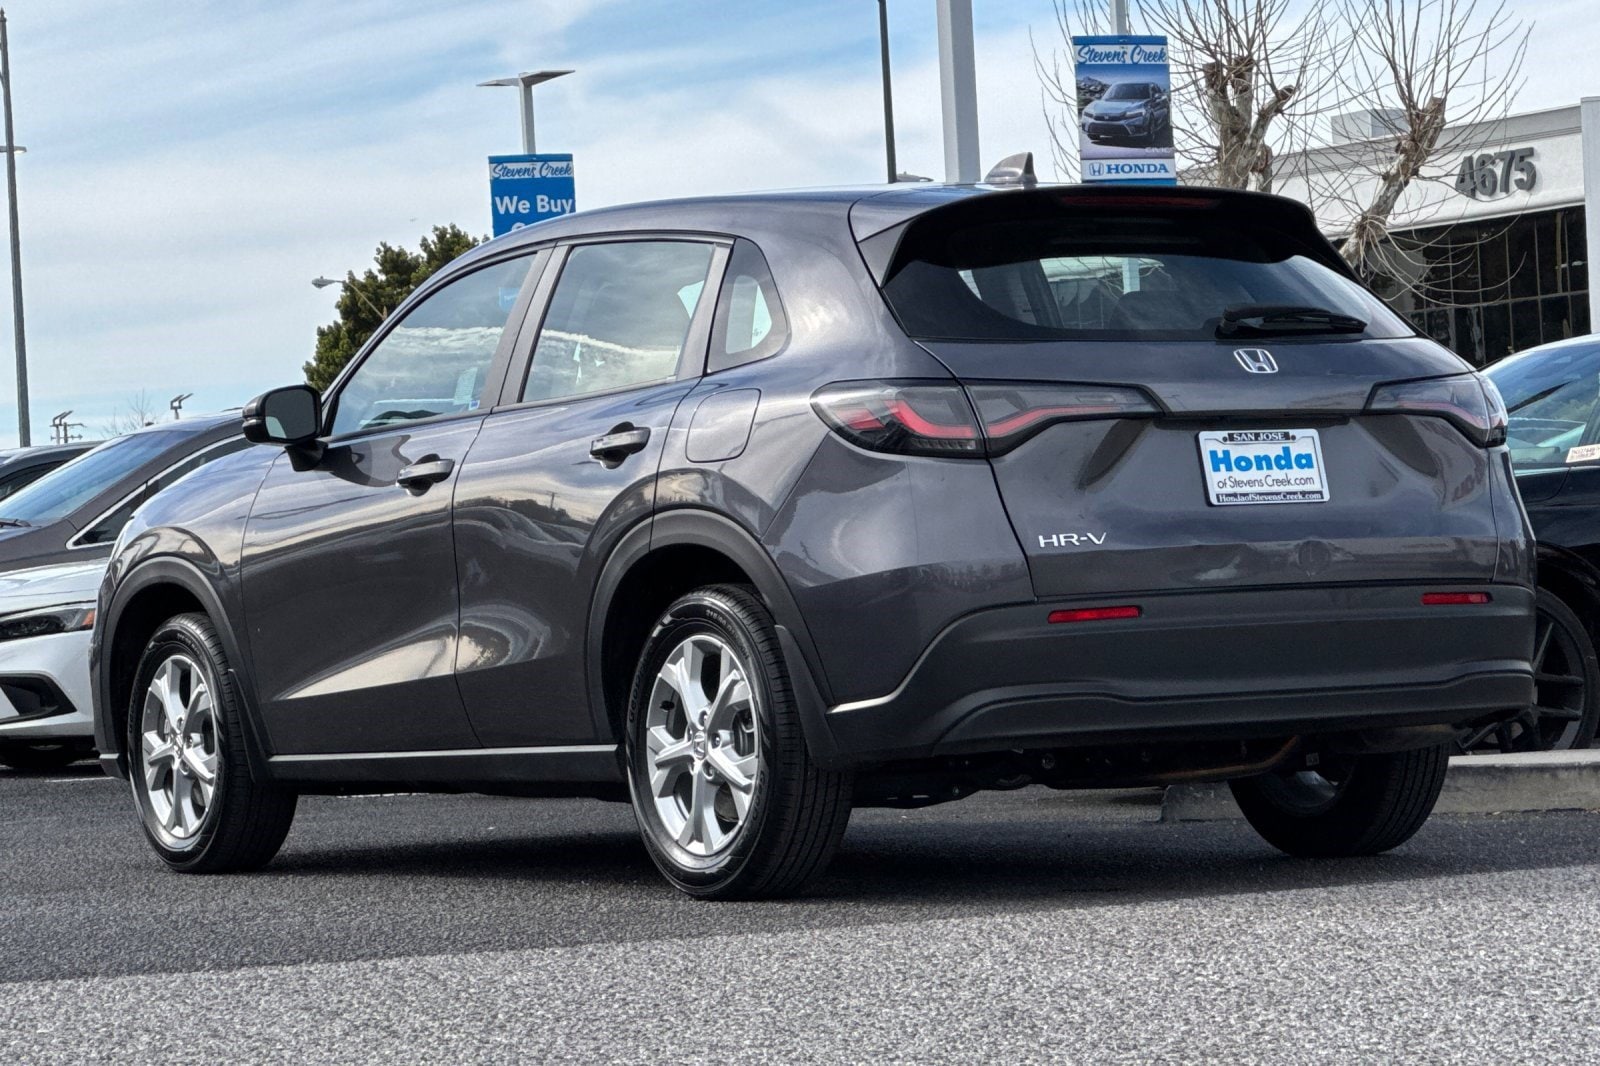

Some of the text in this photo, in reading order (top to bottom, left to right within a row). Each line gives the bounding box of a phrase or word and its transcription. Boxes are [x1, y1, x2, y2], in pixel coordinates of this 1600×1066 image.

[1077, 44, 1167, 64] Stevens Creek
[493, 162, 572, 178] Stevens Creek
[1106, 163, 1169, 174] HONDA
[1455, 147, 1537, 199] 4675
[494, 195, 573, 215] We Buy
[1233, 432, 1286, 441] SAN JOSE
[1209, 446, 1314, 472] Honda
[1217, 473, 1315, 489] of Stevens Creek.com
[1038, 532, 1107, 548] HR-V
